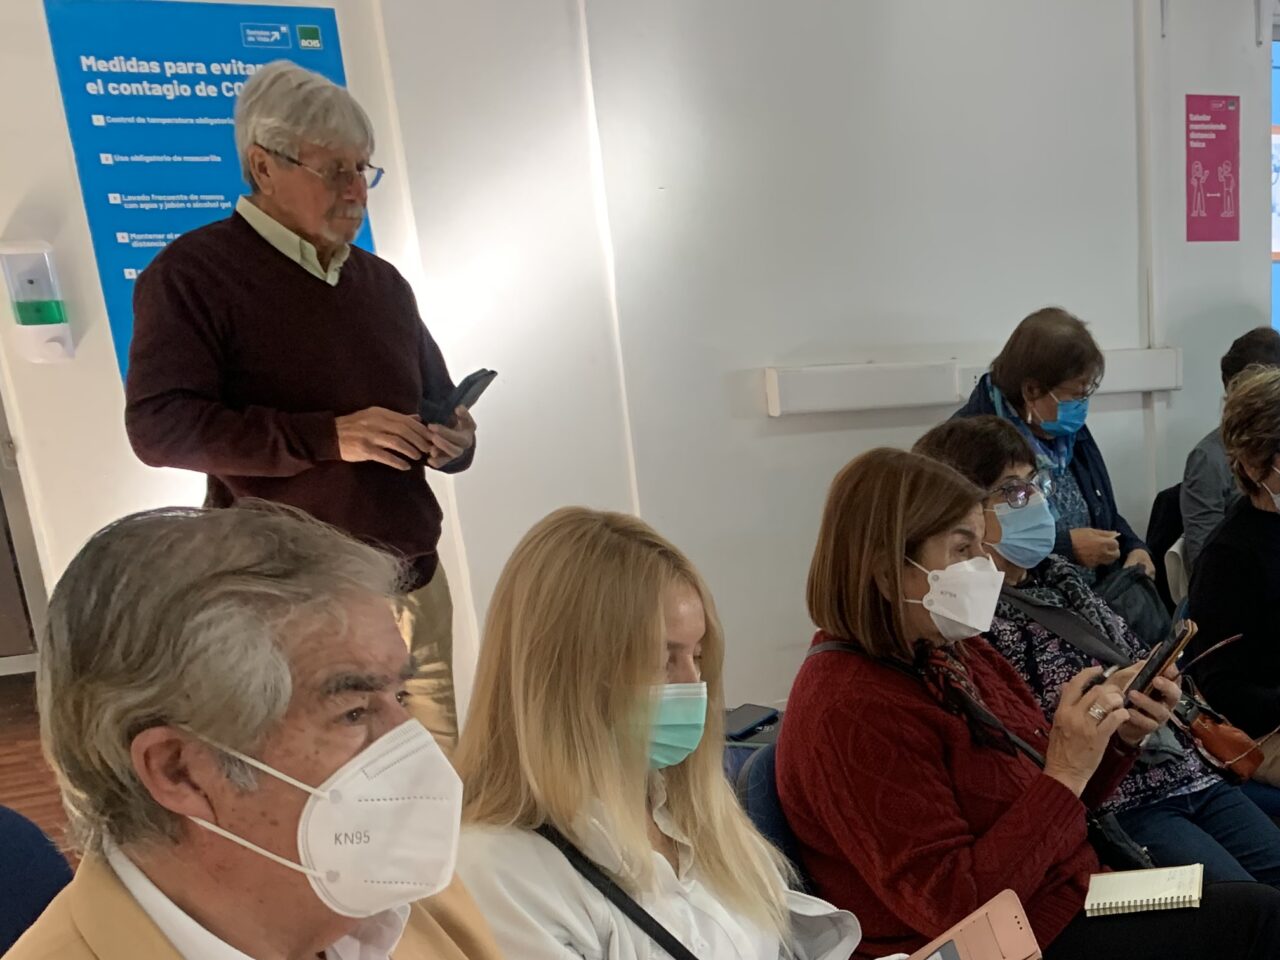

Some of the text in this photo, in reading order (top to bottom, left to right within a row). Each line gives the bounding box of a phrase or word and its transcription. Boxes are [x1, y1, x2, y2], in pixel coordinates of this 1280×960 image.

[80, 55, 161, 74] Medidas
[164, 60, 207, 77] para
[86, 79, 104, 95] el
[107, 80, 192, 100] contagio
[195, 82, 218, 97] de
[333, 830, 371, 845] KN95
